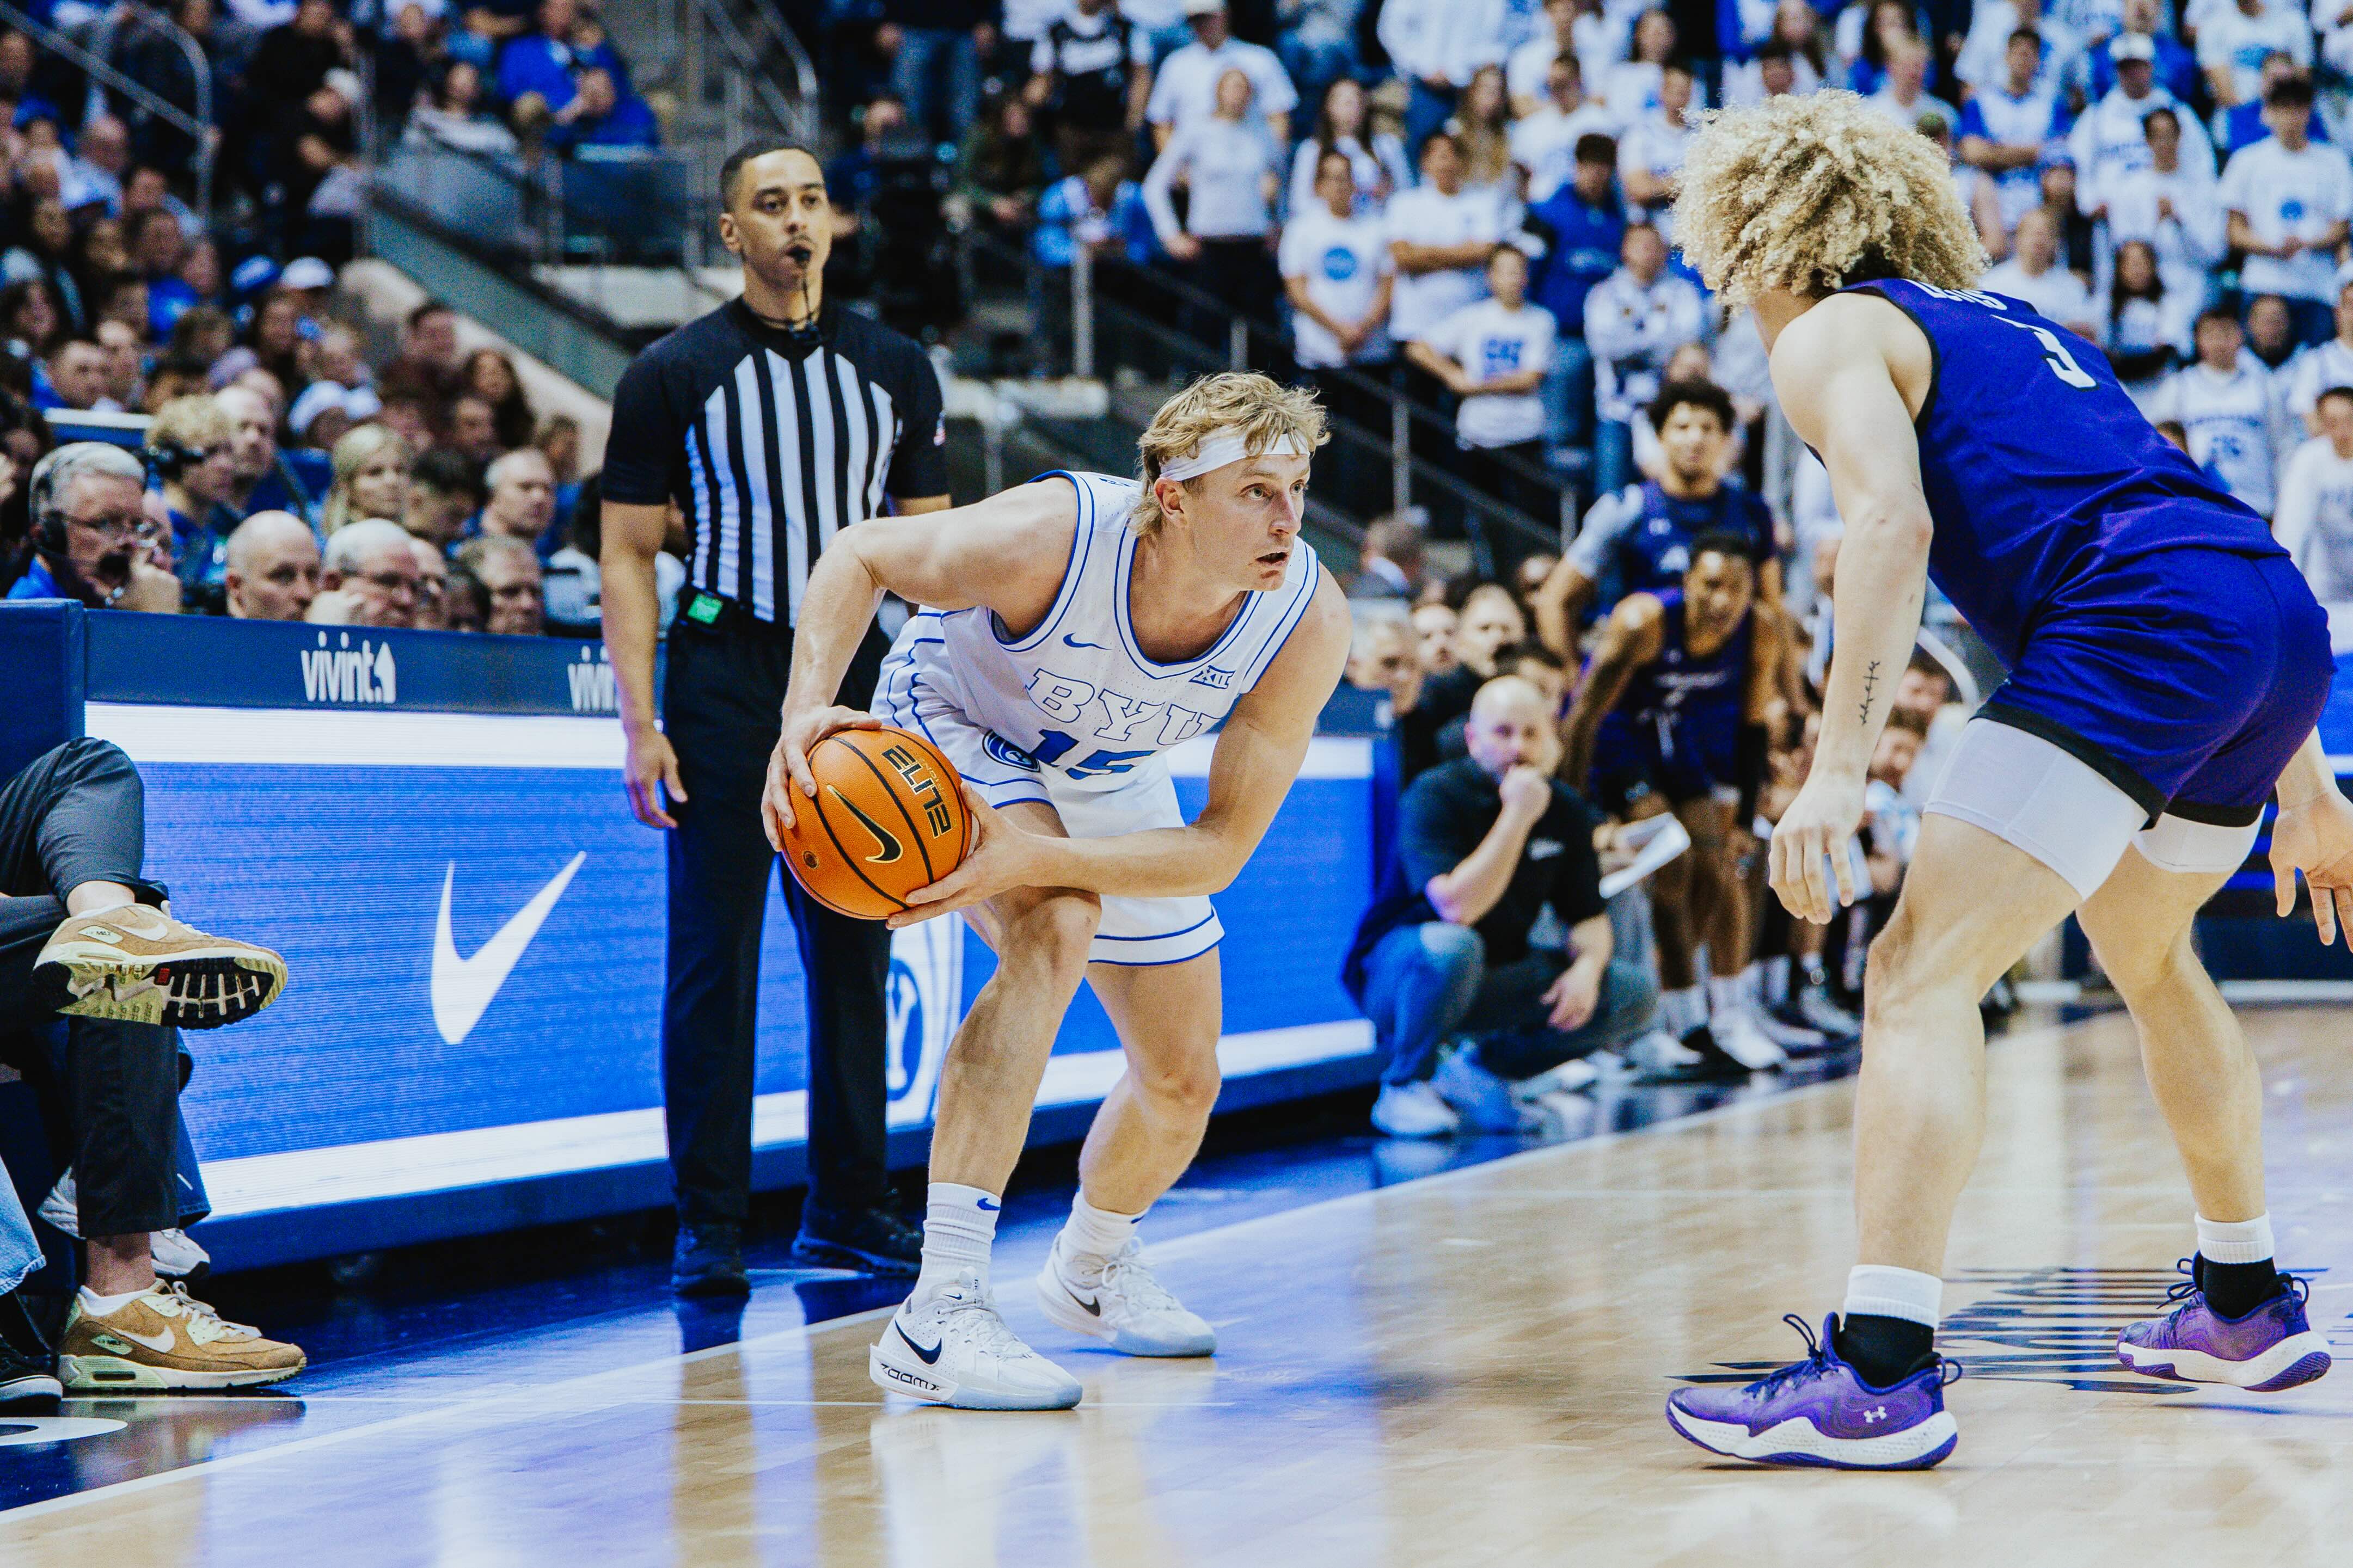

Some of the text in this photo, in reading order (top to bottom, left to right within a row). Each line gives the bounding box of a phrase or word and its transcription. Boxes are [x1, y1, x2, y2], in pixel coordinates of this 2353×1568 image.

[1990, 314, 2097, 388] 3
[1025, 668, 1225, 746] BYU
[881, 744, 953, 839] ELITE
